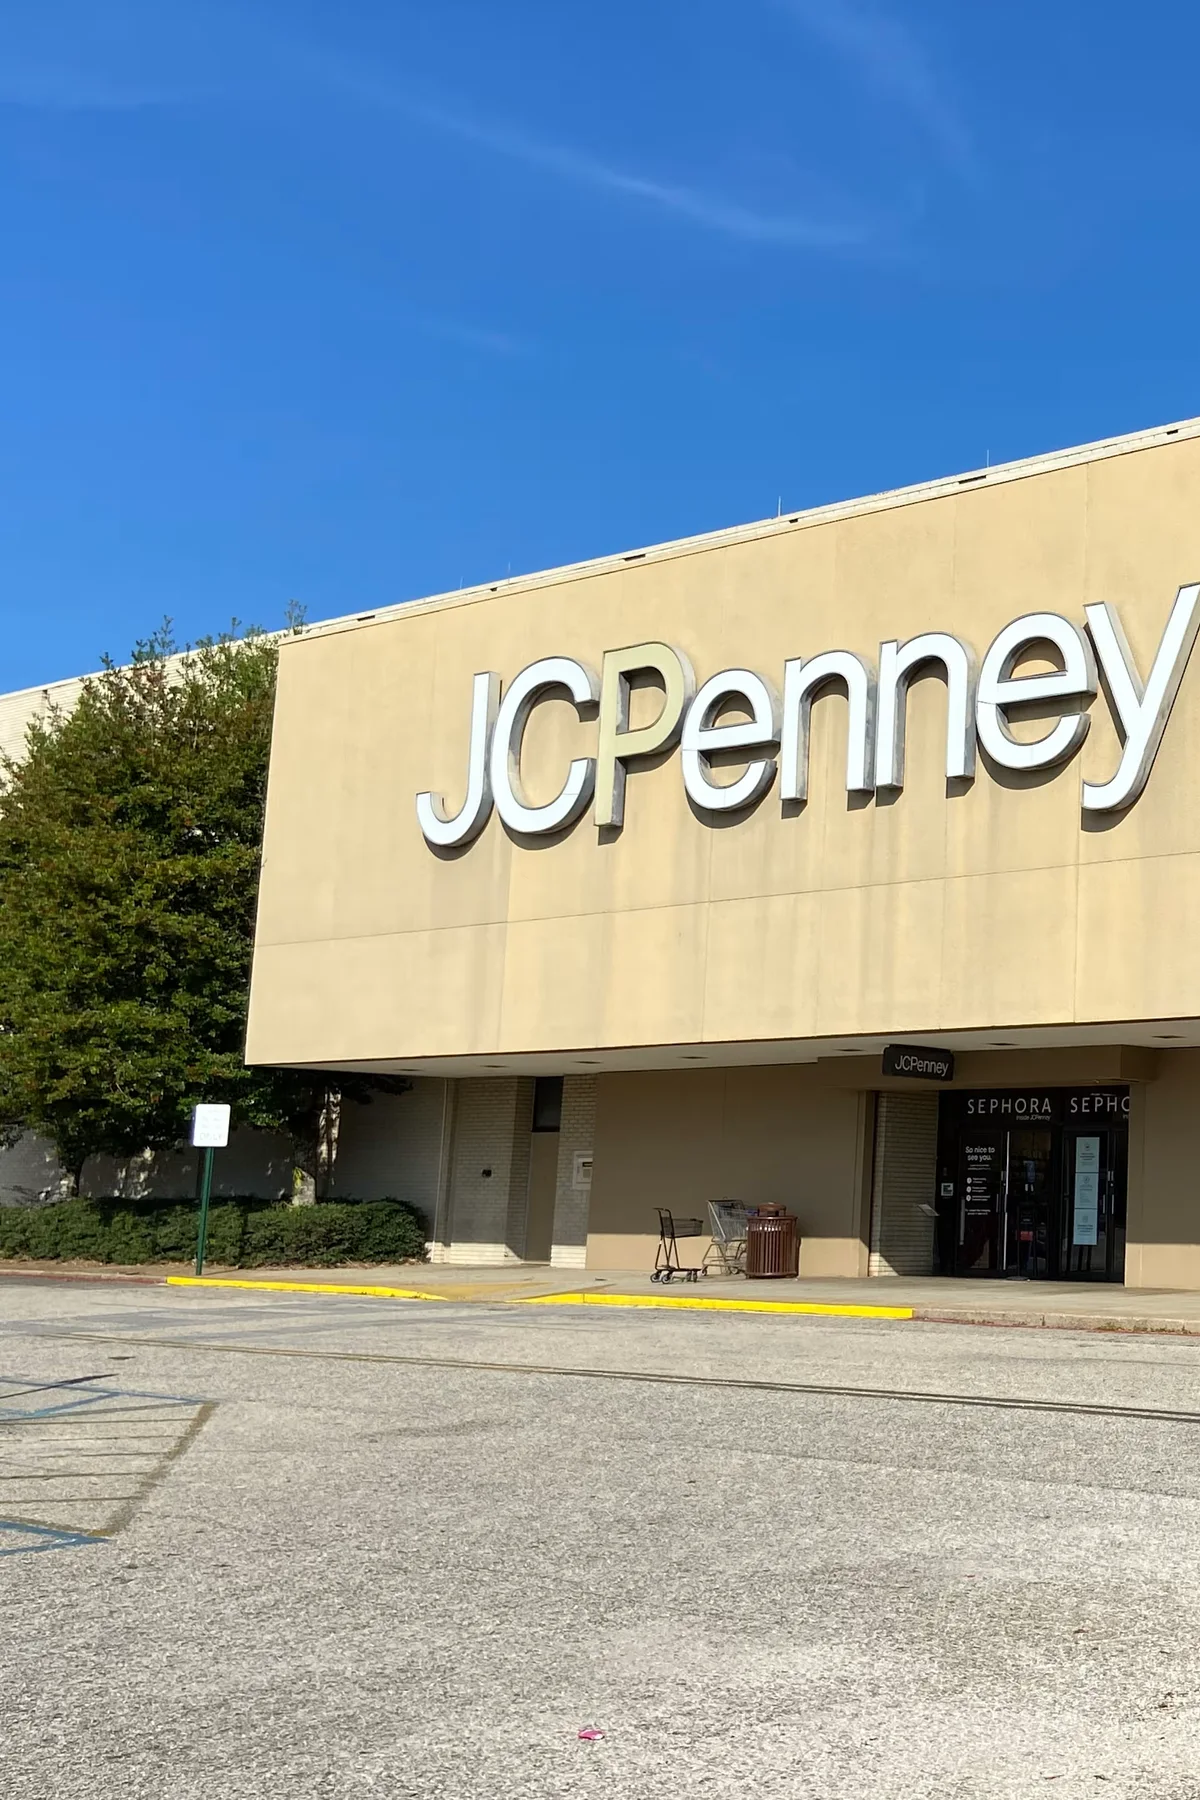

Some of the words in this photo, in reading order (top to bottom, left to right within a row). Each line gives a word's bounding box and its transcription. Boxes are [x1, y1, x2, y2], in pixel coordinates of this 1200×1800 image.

[894, 1054, 949, 1077] JCPenney
[967, 1097, 1052, 1114] SEPHORA
[965, 1145, 974, 1154] So
[974, 1145, 988, 1154] nice
[988, 1146, 996, 1154] to
